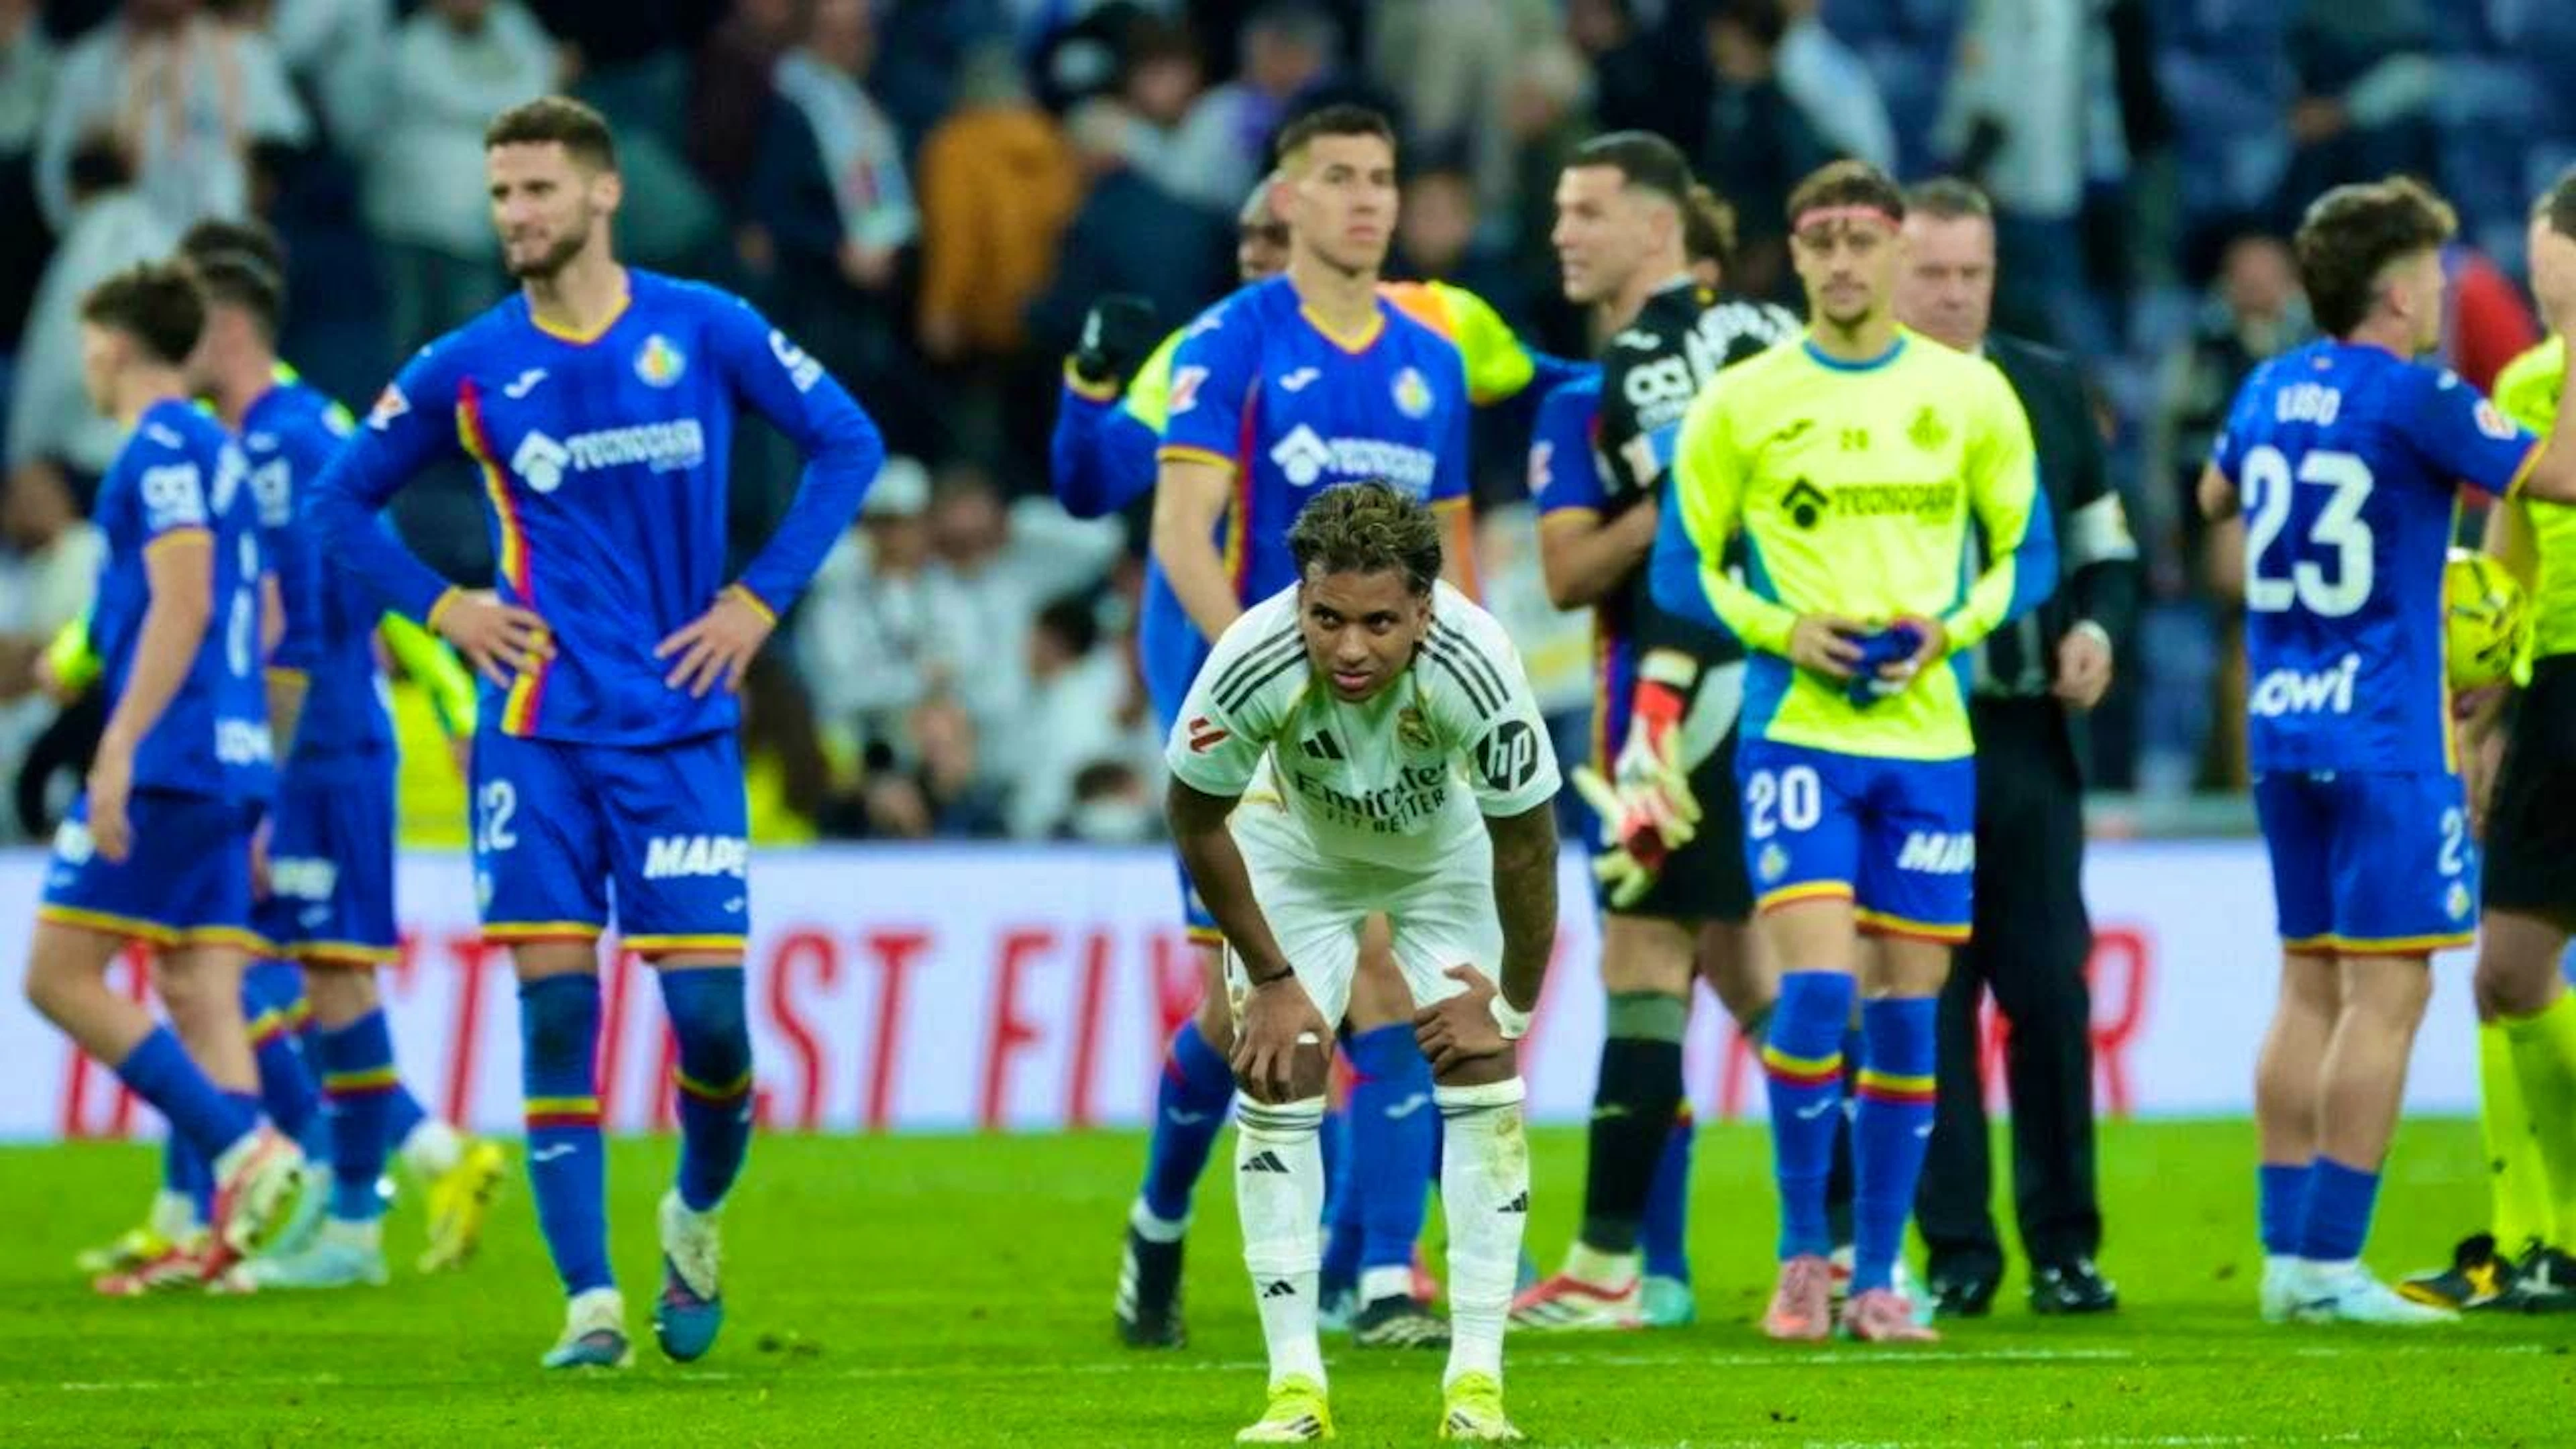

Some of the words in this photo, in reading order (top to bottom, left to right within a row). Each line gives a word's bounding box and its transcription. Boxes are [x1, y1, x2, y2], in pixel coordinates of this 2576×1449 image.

[2241, 443, 2375, 617] 23
[1486, 723, 1532, 793] hp
[1746, 765, 1821, 840] 20
[2438, 807, 2474, 877] 2
